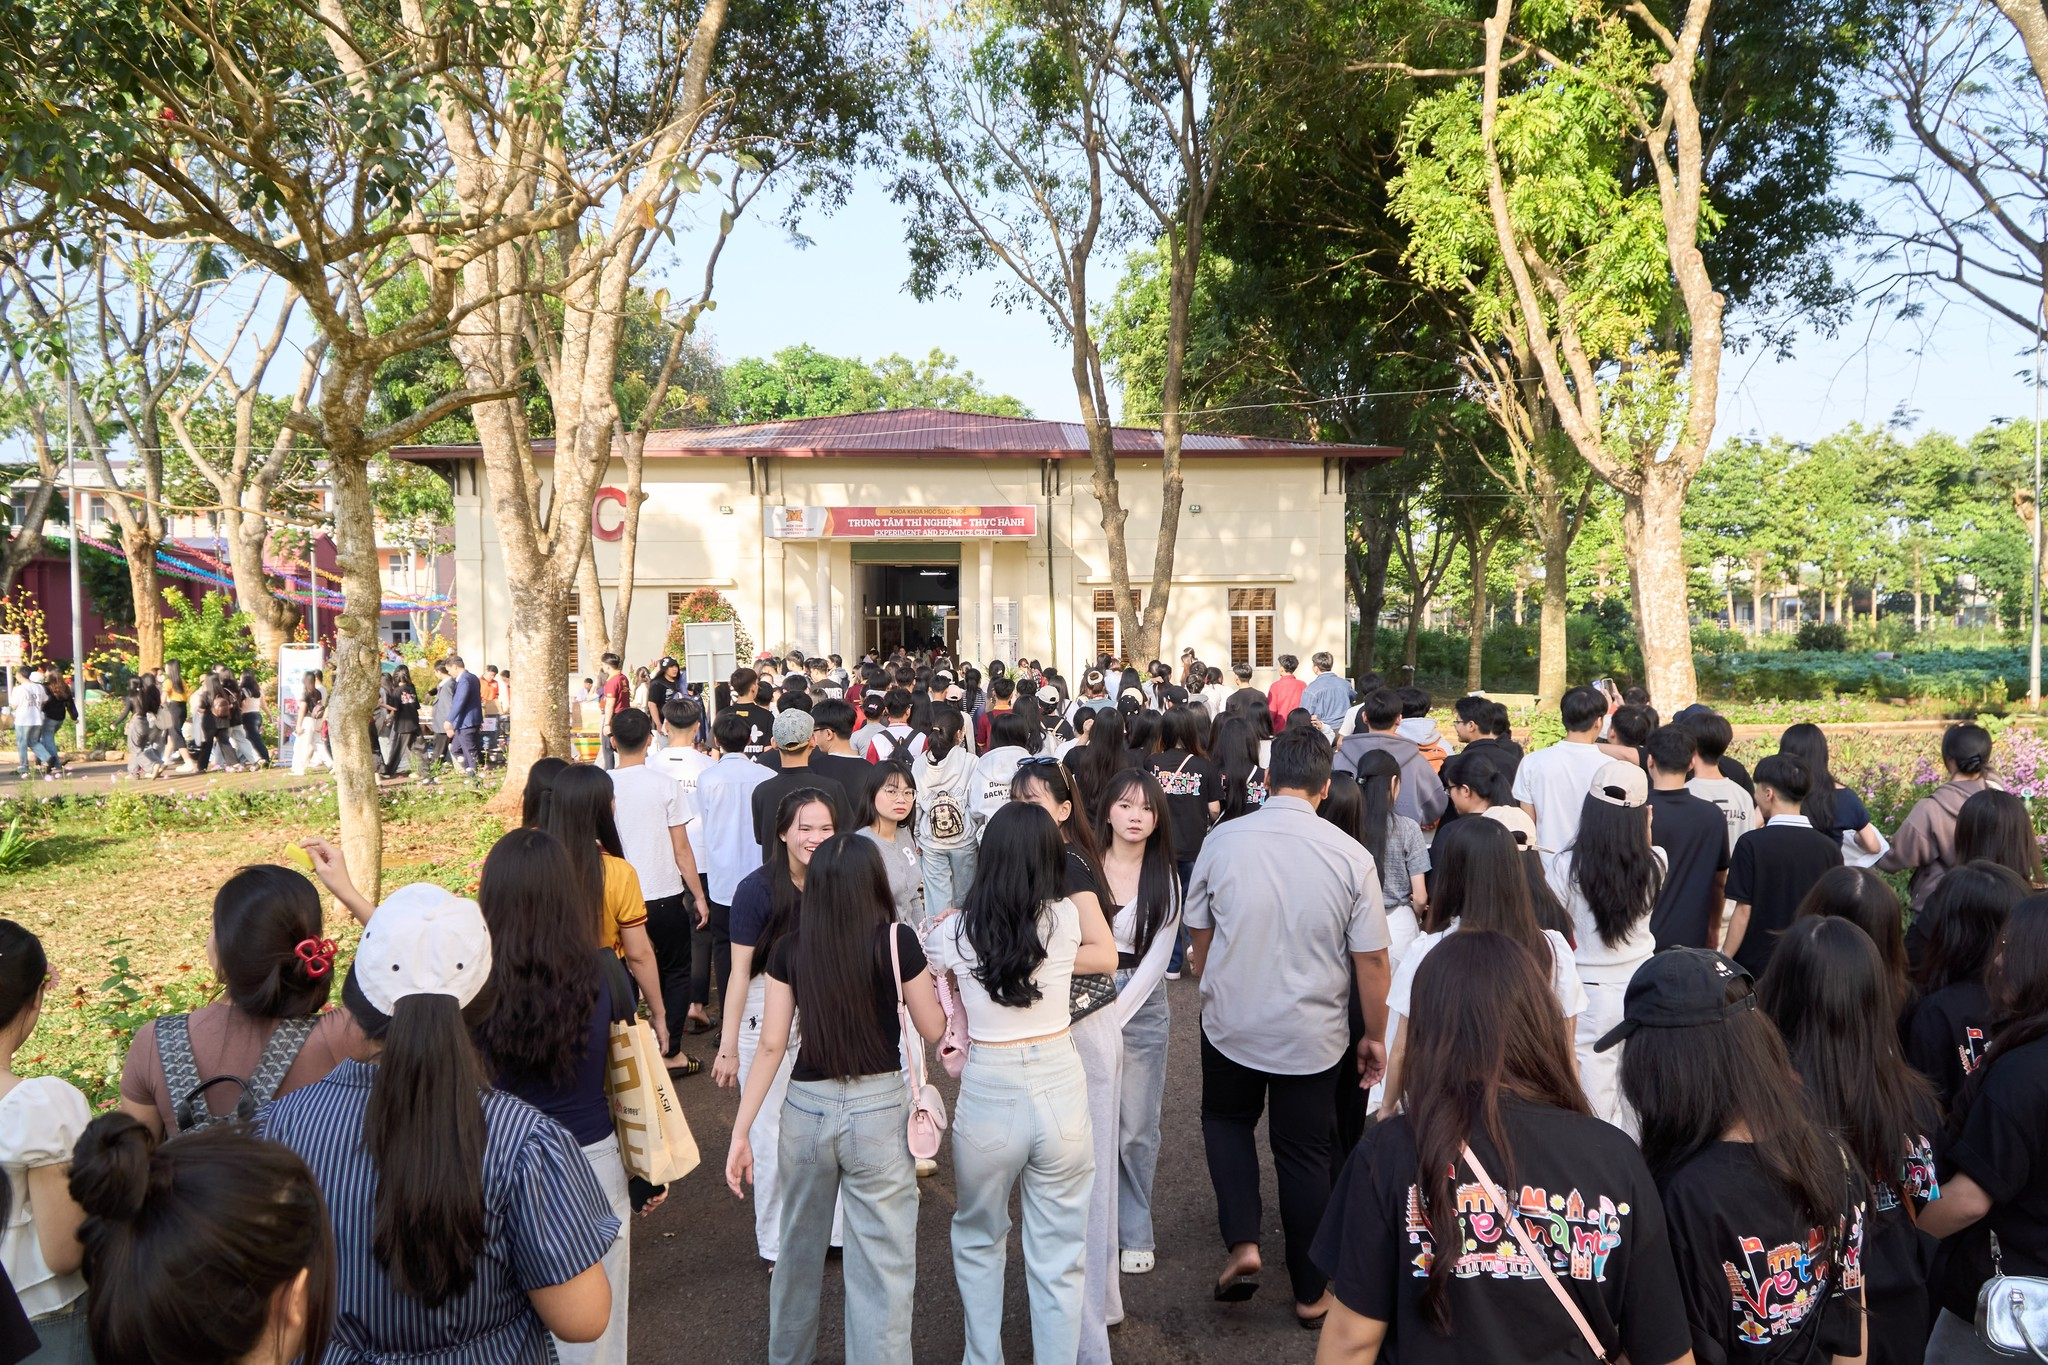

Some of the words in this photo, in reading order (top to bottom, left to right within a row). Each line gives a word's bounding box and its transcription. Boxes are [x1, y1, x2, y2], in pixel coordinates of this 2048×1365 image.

[591, 486, 627, 542] C
[786, 508, 803, 522] M
[848, 518, 881, 527] TRUNG
[882, 516, 904, 527] TÂM
[905, 516, 922, 527] THÍ
[923, 517, 962, 528] NGHIỆM
[969, 518, 997, 528] THỰC
[998, 516, 1025, 527] HÀNH
[983, 789, 1003, 800] BACK
